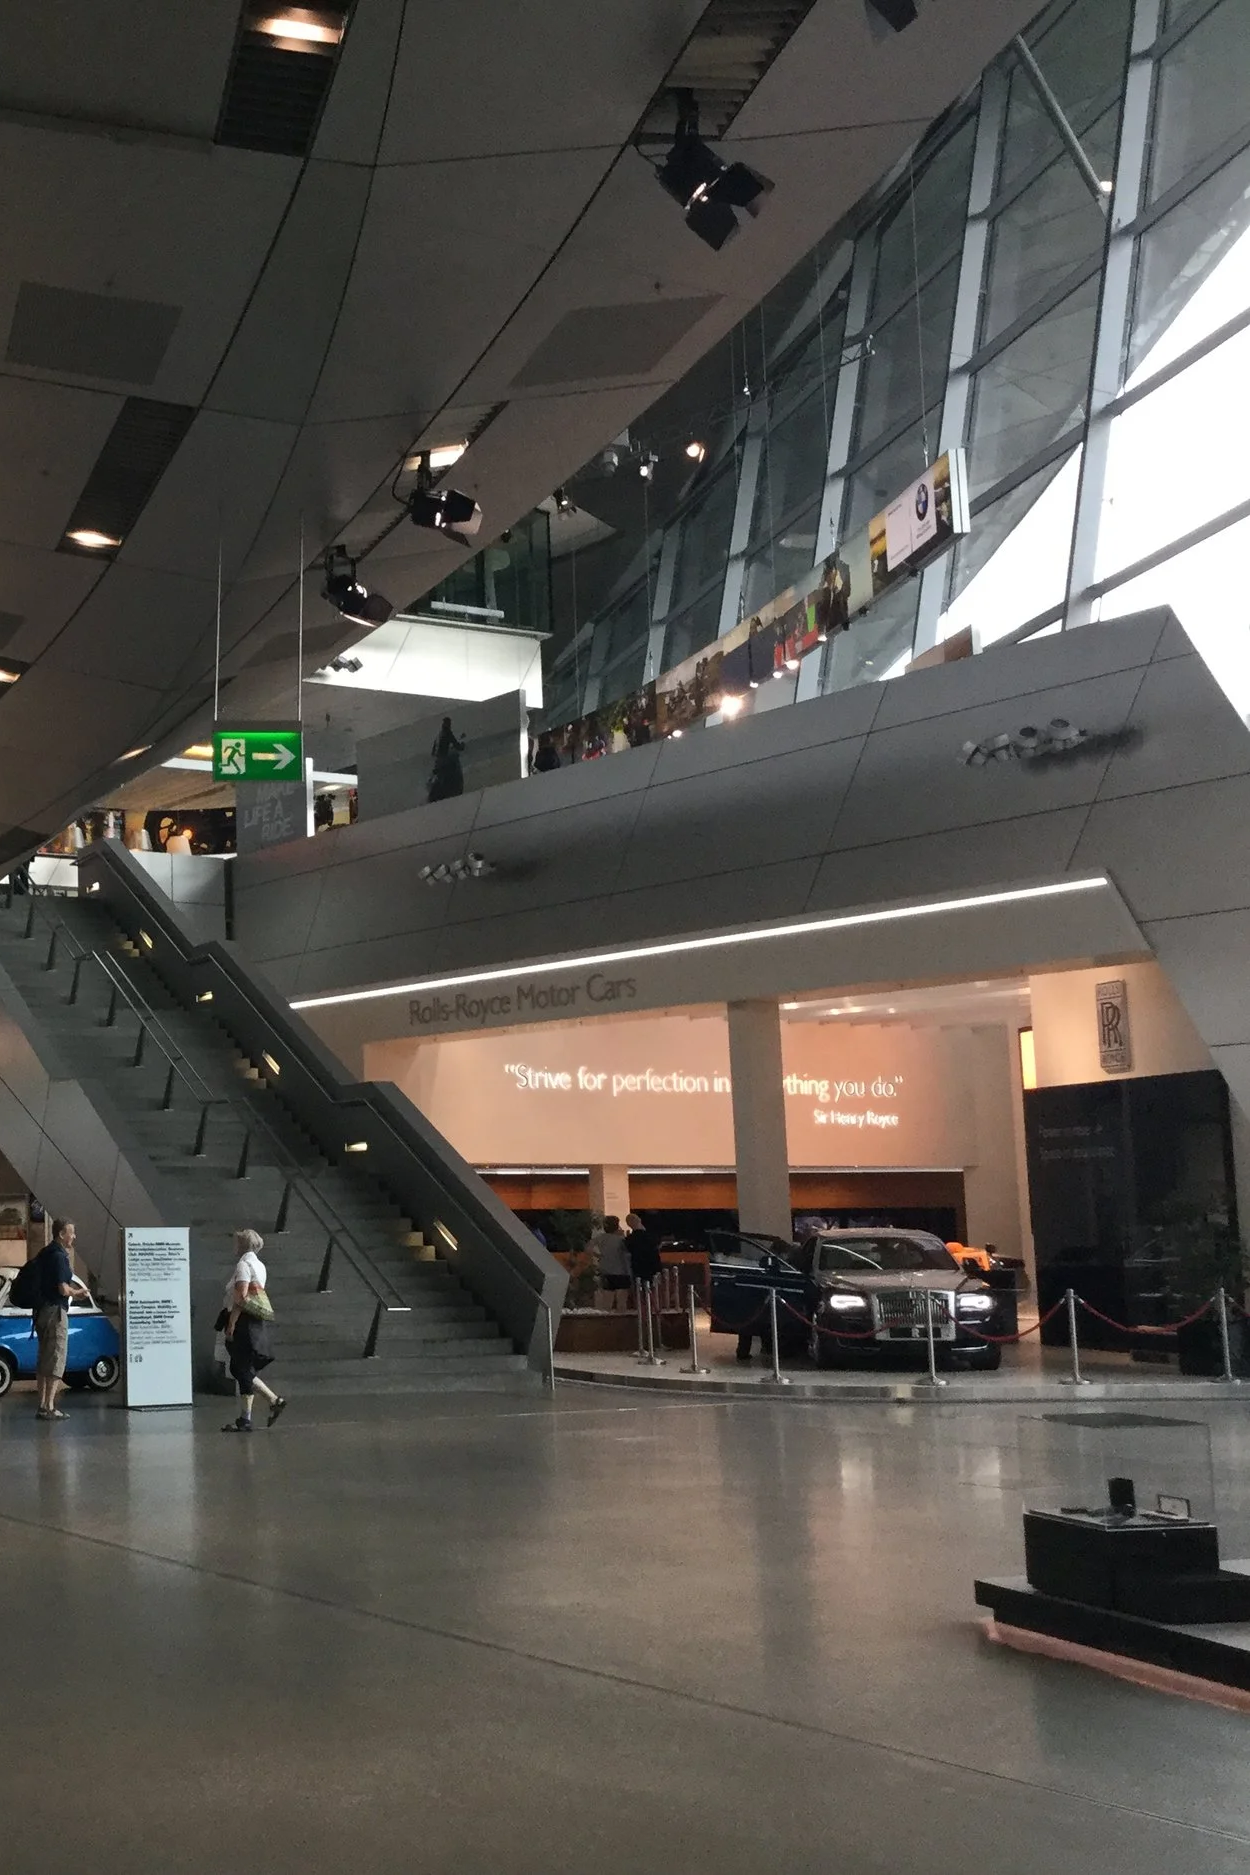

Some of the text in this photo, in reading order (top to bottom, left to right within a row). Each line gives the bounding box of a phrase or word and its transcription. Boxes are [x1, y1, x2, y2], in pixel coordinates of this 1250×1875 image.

[408, 973, 637, 1026] Rolls-Royce Motor Cars
[577, 1066, 607, 1091] for
[612, 1068, 709, 1097] perfection
[714, 1070, 732, 1093] in
[783, 1073, 830, 1103] thing
[834, 1081, 865, 1104] you
[813, 1108, 899, 1128] Sir Henry Royce
